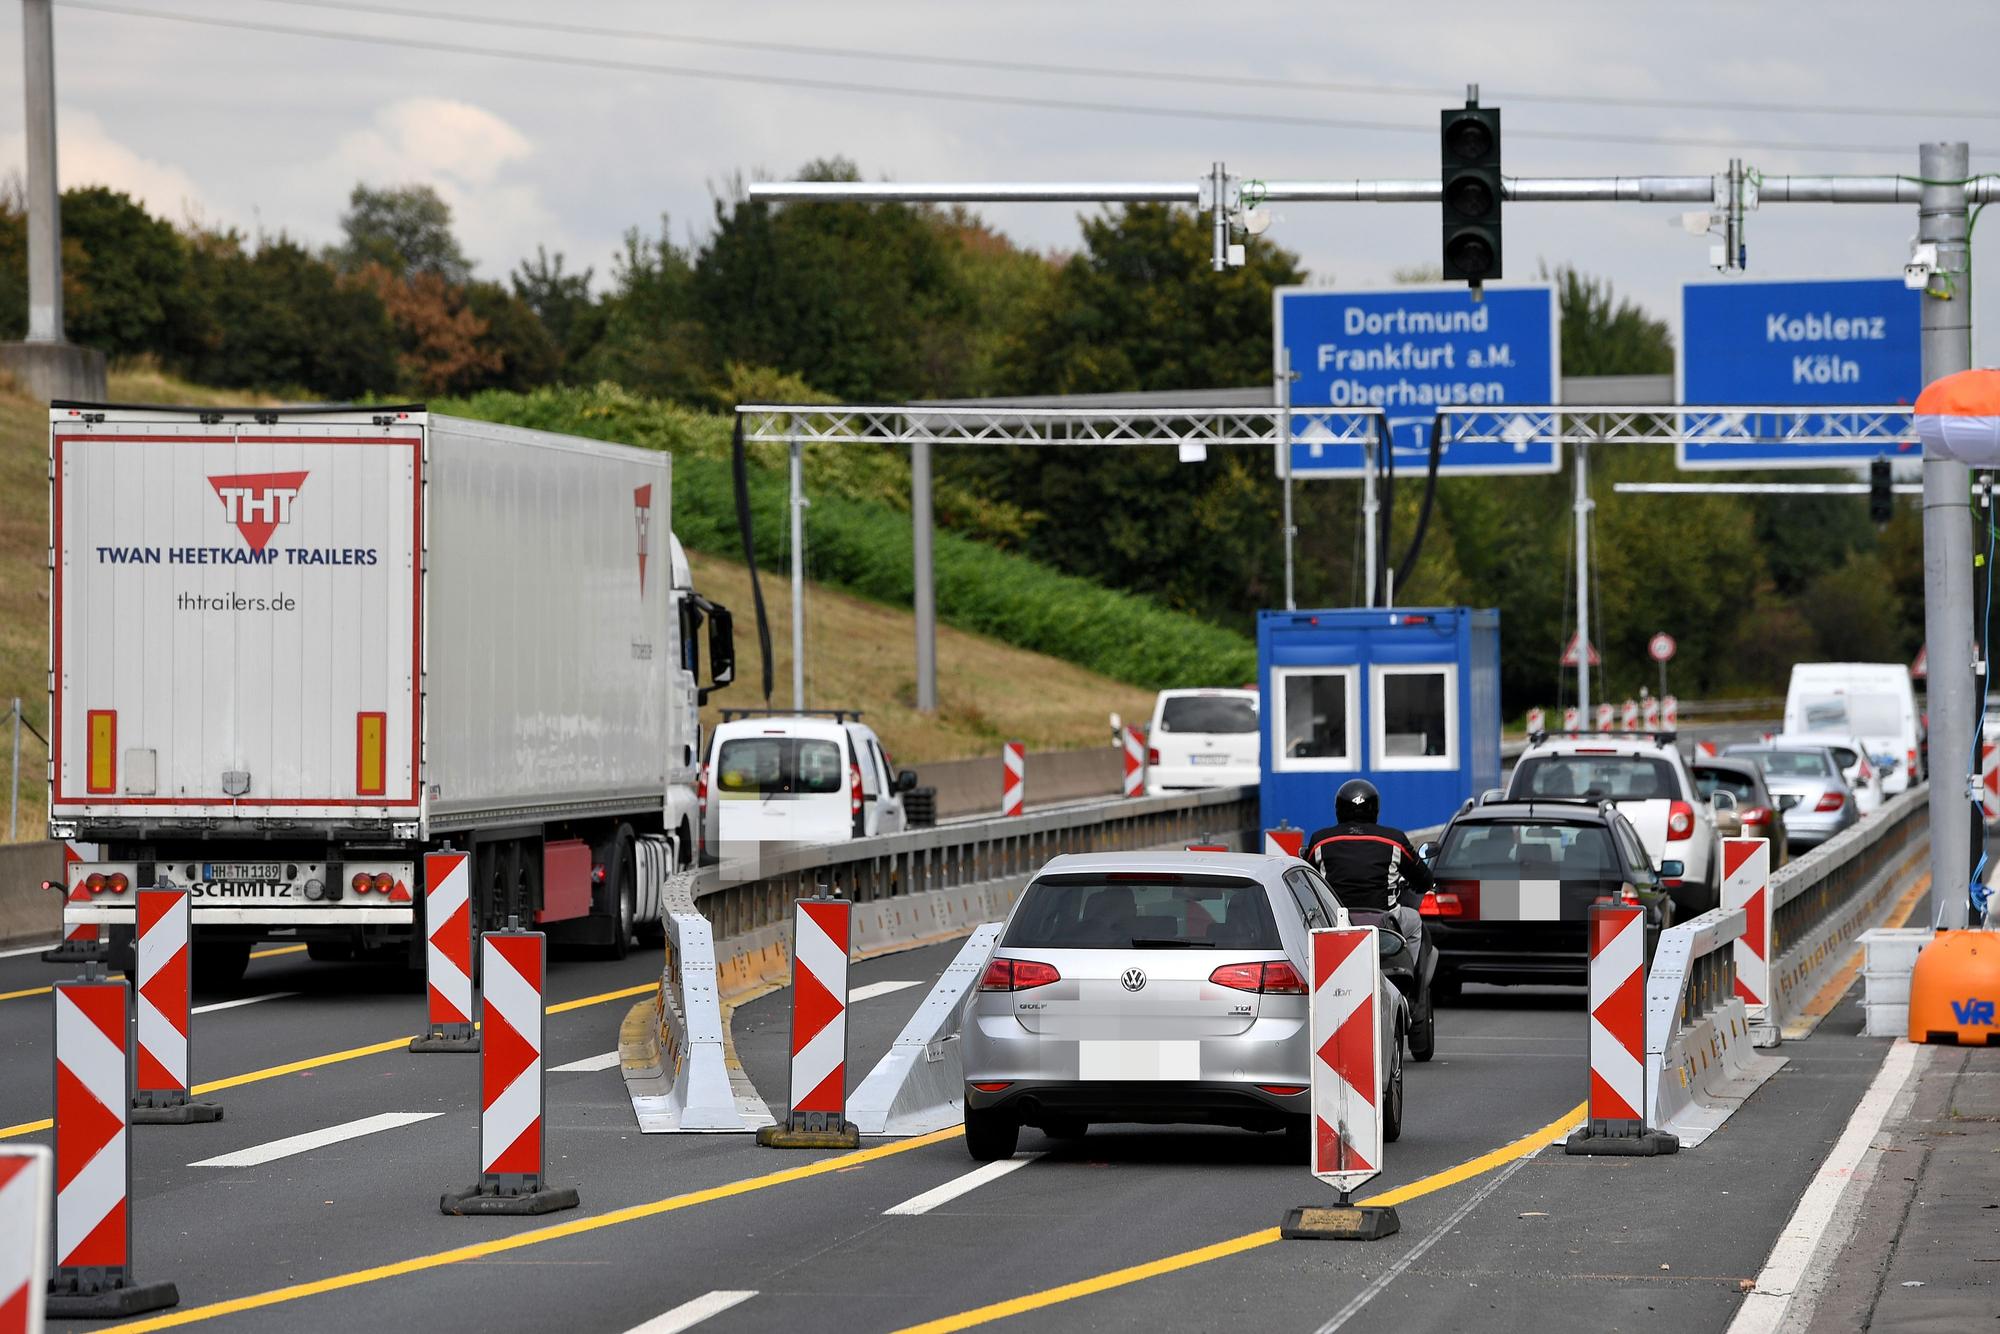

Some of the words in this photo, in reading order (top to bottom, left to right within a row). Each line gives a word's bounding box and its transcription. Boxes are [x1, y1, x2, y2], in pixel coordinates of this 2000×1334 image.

[1344, 305, 1488, 335] Dortmund
[1766, 311, 1886, 342] Koblenz
[1317, 342, 1455, 371] Frankfurt
[1467, 343, 1516, 369] a.M.
[1792, 354, 1860, 384] Köln
[1330, 378, 1504, 406] Oberhausen
[219, 487, 297, 523] THT
[96, 547, 161, 564] TWAN
[169, 548, 278, 564] HEETKAMP
[285, 549, 377, 565] TRAILERS
[177, 592, 295, 611] thtrailers.de
[211, 865, 226, 878] HH
[236, 865, 249, 878] TH
[252, 865, 279, 878] 1189
[191, 882, 292, 897] SCHMITZ
